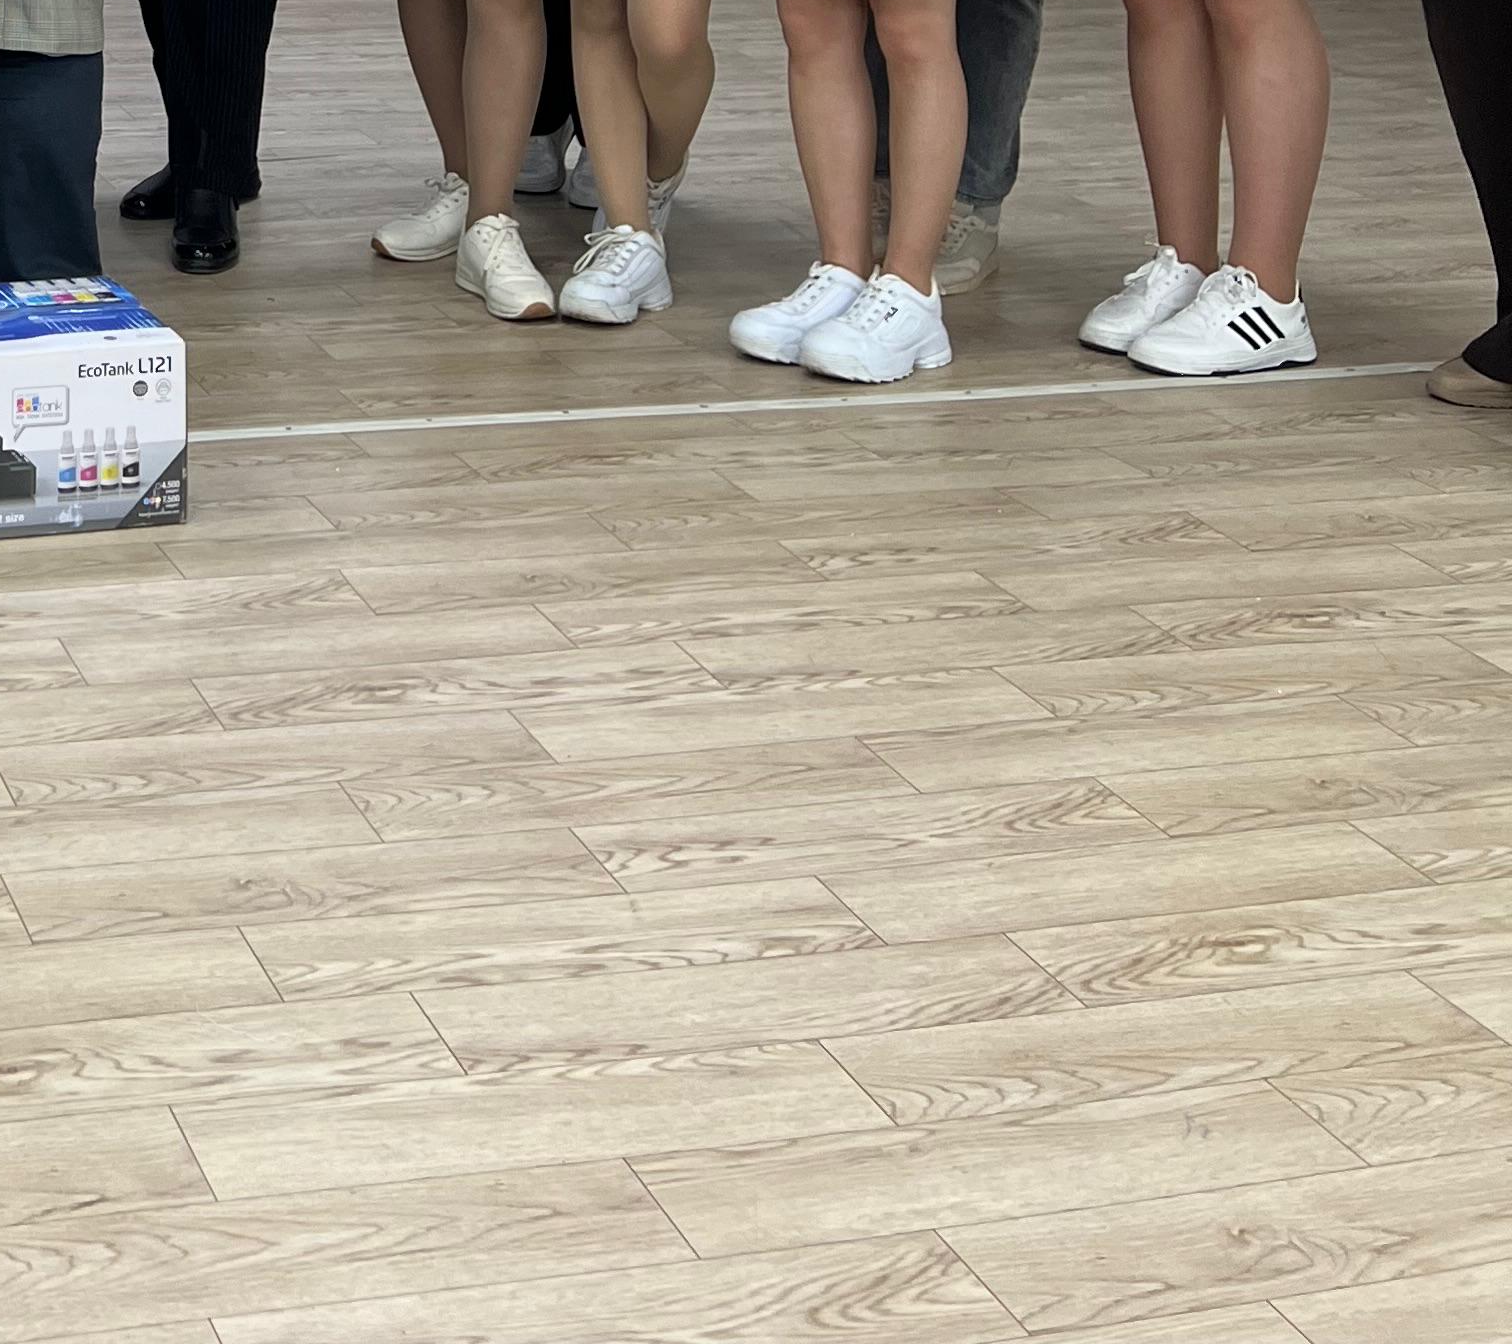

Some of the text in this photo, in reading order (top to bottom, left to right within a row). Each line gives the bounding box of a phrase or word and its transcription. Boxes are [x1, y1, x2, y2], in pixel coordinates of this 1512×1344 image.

[78, 356, 172, 378] EcoTank L121
[5, 513, 25, 523] size
